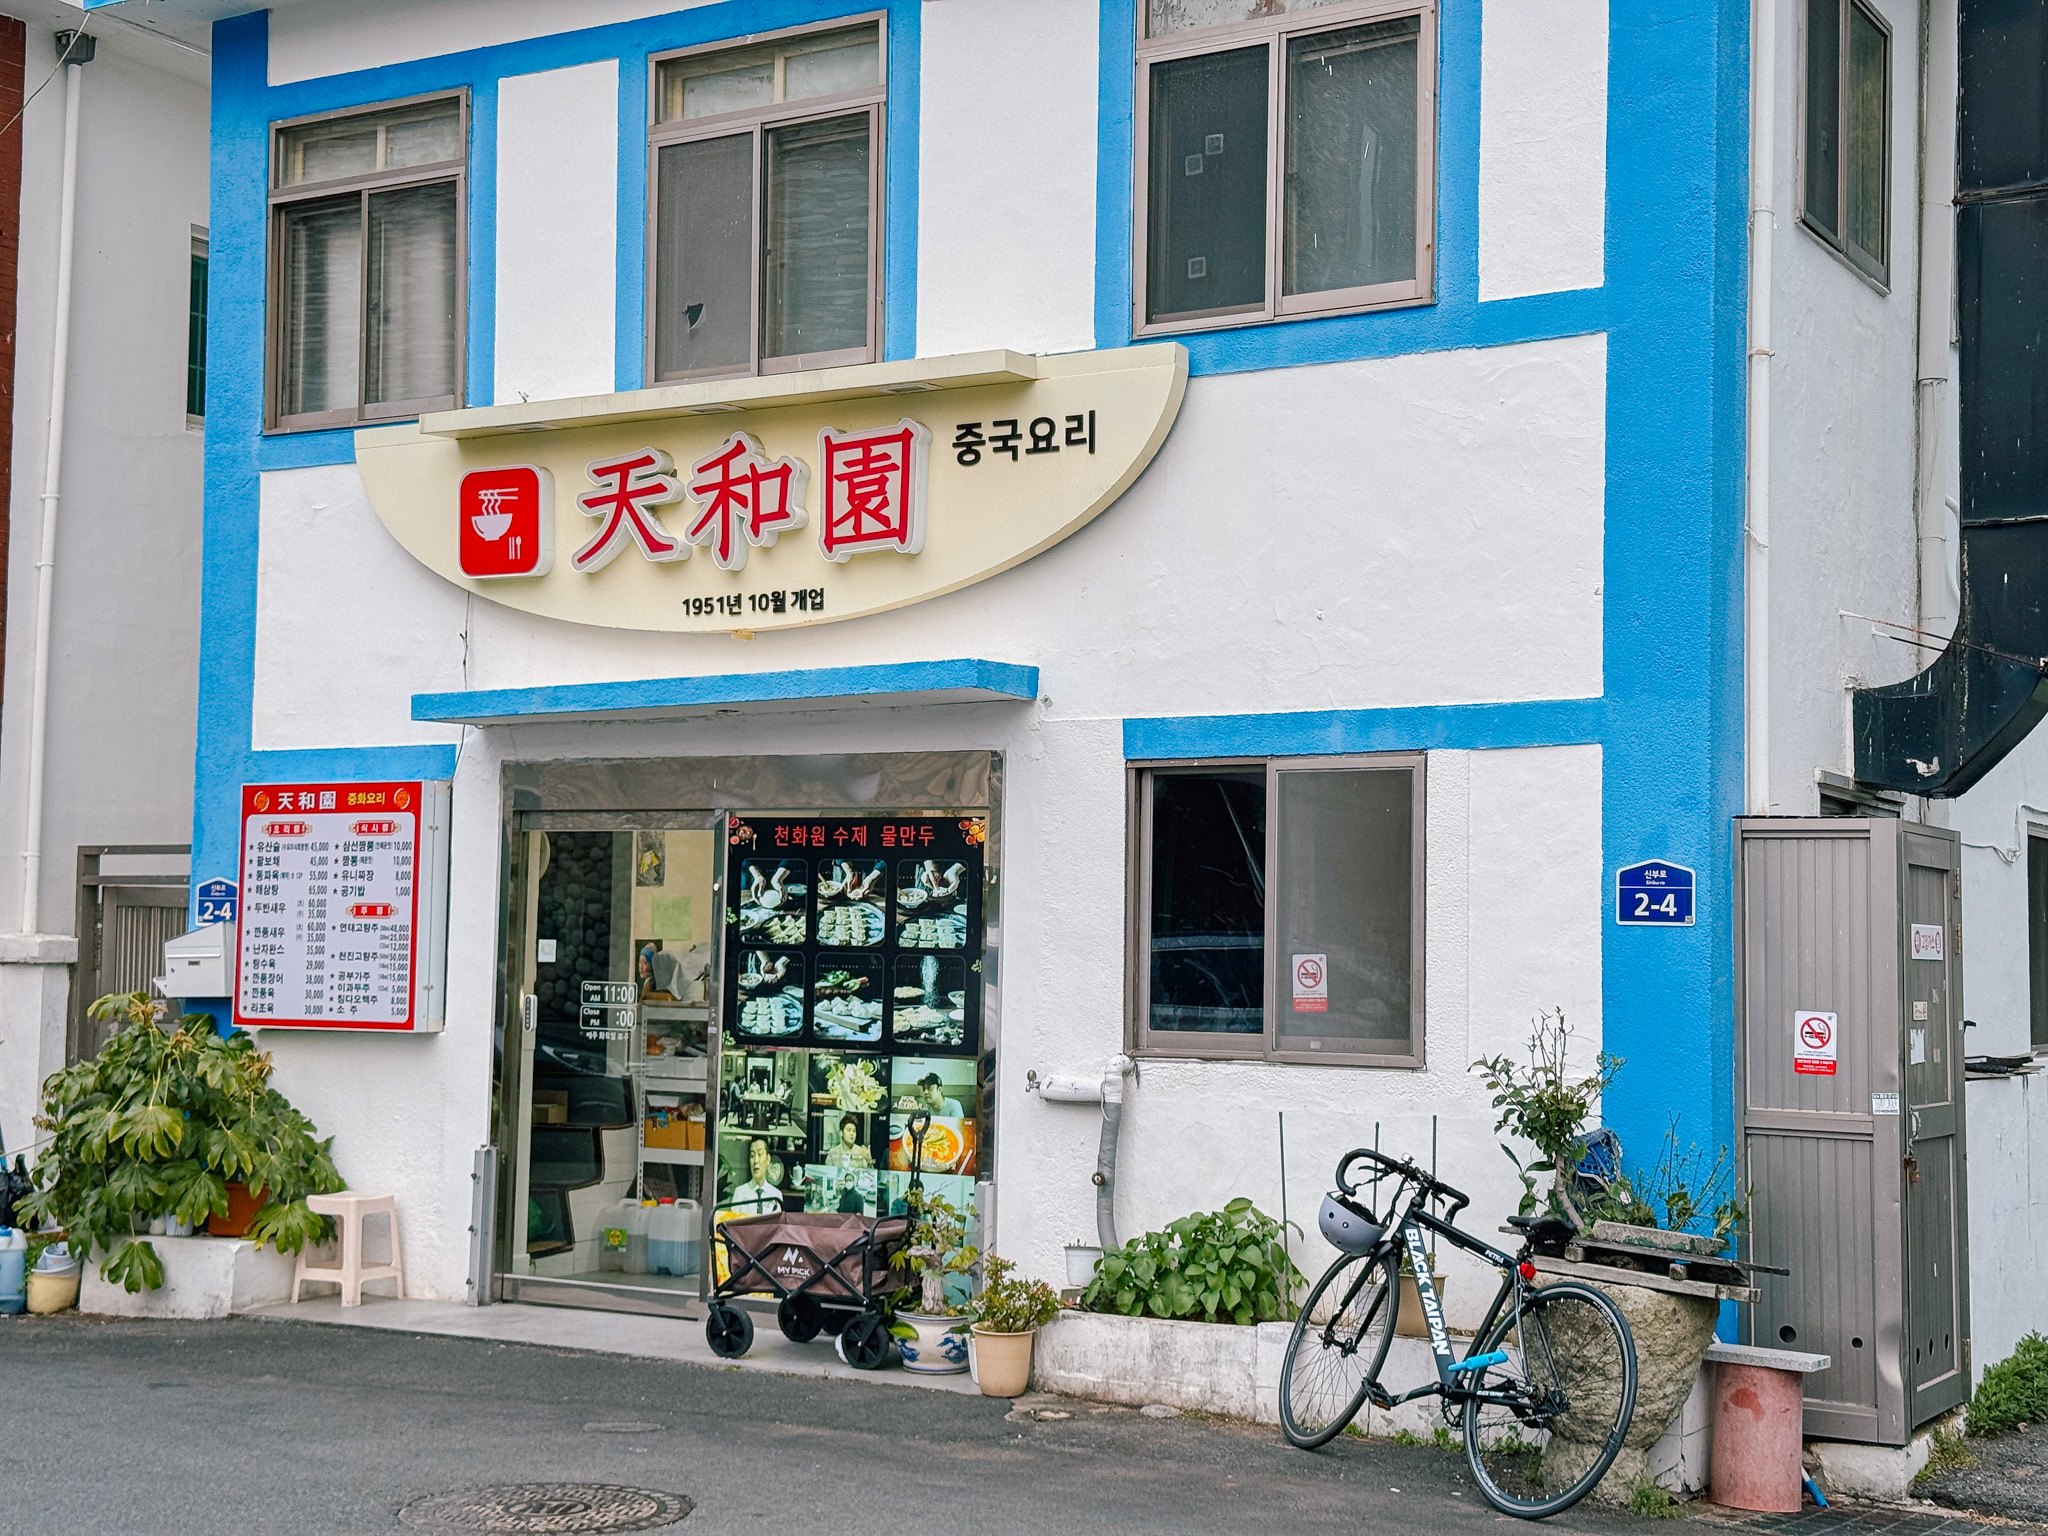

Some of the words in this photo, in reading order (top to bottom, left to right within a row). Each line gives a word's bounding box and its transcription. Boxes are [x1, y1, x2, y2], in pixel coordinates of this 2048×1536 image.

[952, 409, 1096, 467] 중국요리
[575, 426, 917, 565] 天和園
[682, 593, 742, 616] 1951년
[748, 590, 787, 614] 10월
[790, 587, 825, 612] 개업
[277, 790, 337, 811] 天和園
[347, 791, 386, 806] 중화요리
[774, 825, 826, 847] 천화원
[832, 825, 868, 847] 수제
[880, 825, 936, 847] 물만두
[257, 841, 280, 853] 유산슬
[310, 841, 330, 852] 45,000
[343, 840, 375, 852] 삼선짬뽕
[393, 841, 413, 852] 10,000
[257, 856, 280, 867] 팔보채
[310, 856, 329, 867] 45,000
[342, 855, 358, 867] 짬뽕
[393, 855, 412, 867] 10,000
[256, 870, 279, 881] 동파육
[309, 870, 328, 881] 55,000
[341, 869, 375, 881] 유니짜장
[395, 870, 412, 882] 8,000
[1643, 869, 1668, 880] 신부로
[256, 884, 279, 896] 해삼탕
[308, 884, 328, 896] 65,000
[341, 885, 366, 897] 공기밥
[395, 886, 411, 897] 1,000
[203, 901, 233, 920] 2-4
[254, 902, 287, 914] 두반새우
[308, 898, 327, 909] 60,000
[1634, 892, 1678, 917] 2-4
[307, 908, 327, 919] 35,000
[254, 926, 286, 939] 깐풍새우
[307, 921, 326, 932] 60,000
[306, 932, 326, 943] 35,000
[306, 944, 326, 956] 35,000
[252, 958, 276, 970] 탕수육
[305, 959, 325, 971] 29,000
[252, 972, 284, 985] 깐풍장어
[251, 987, 275, 999] 깐풍육
[304, 989, 324, 1000] 30,000
[337, 982, 370, 993] 이과두주
[584, 983, 601, 991] Open
[604, 985, 635, 1002] 11:00
[590, 994, 601, 1002] AM
[304, 1004, 324, 1015] 30,000
[590, 1018, 600, 1026] PM
[1484, 1249, 1504, 1265] PETRA
[777, 1266, 791, 1274] MY
[791, 1267, 811, 1277] PICK
[1404, 1228, 1432, 1287] BLACK
[1421, 1288, 1450, 1355] TAIPAN
